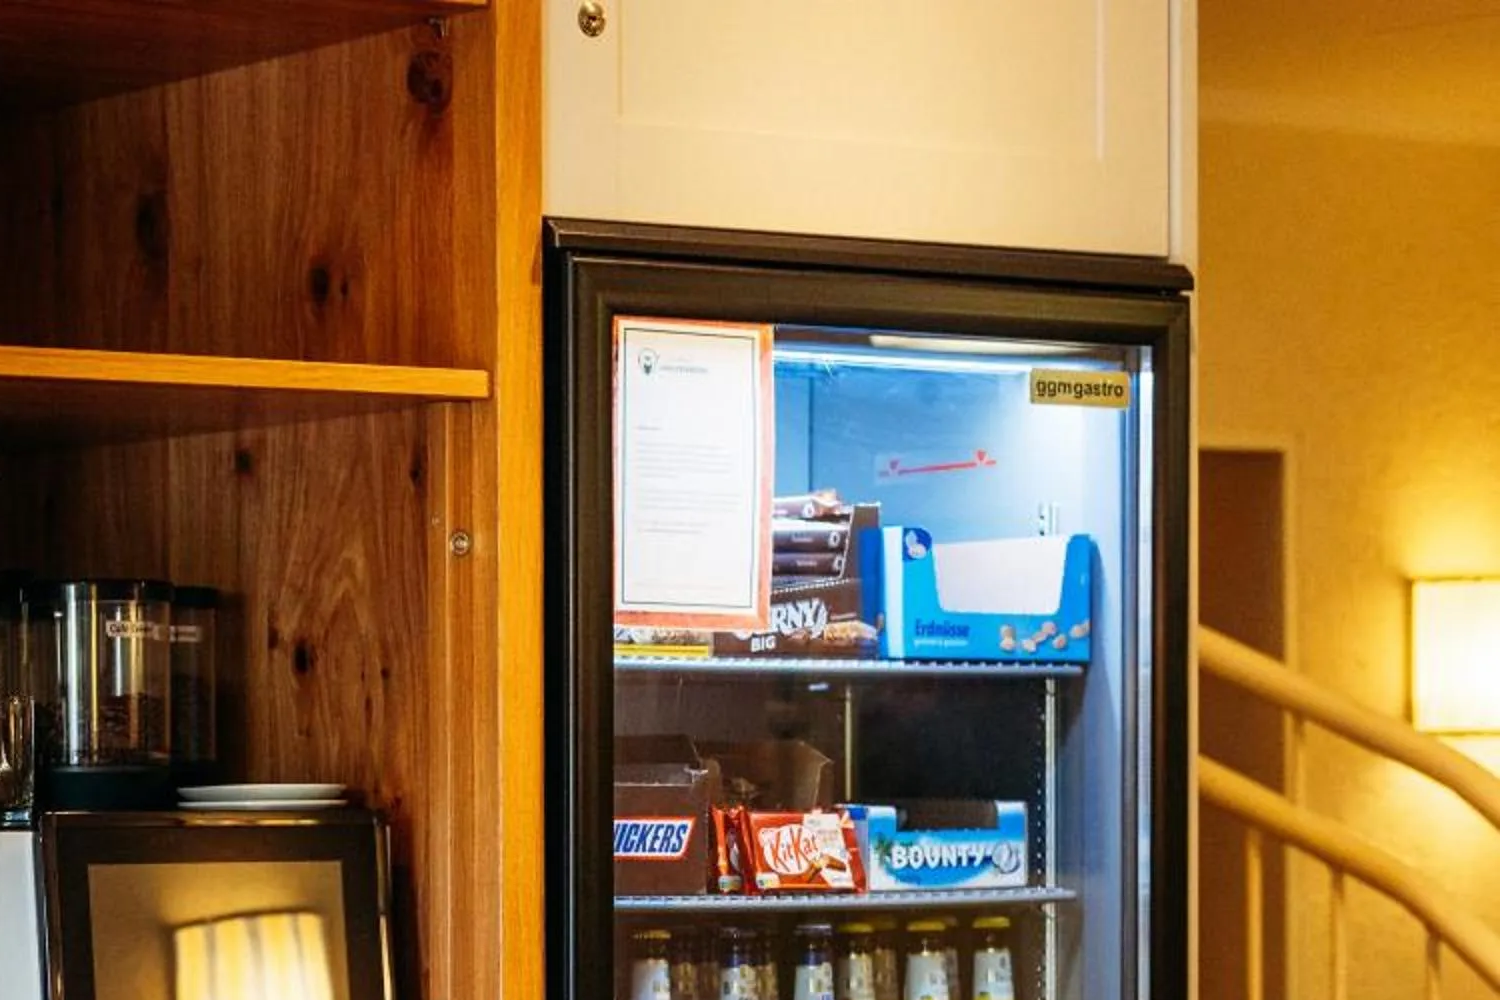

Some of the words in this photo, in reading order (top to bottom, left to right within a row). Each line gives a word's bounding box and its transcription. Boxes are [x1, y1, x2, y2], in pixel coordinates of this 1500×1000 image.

[1036, 380, 1124, 398] ggmgastro
[751, 633, 776, 652] BIG
[613, 823, 688, 853] ICKERS
[891, 843, 986, 869] BOUNTY
